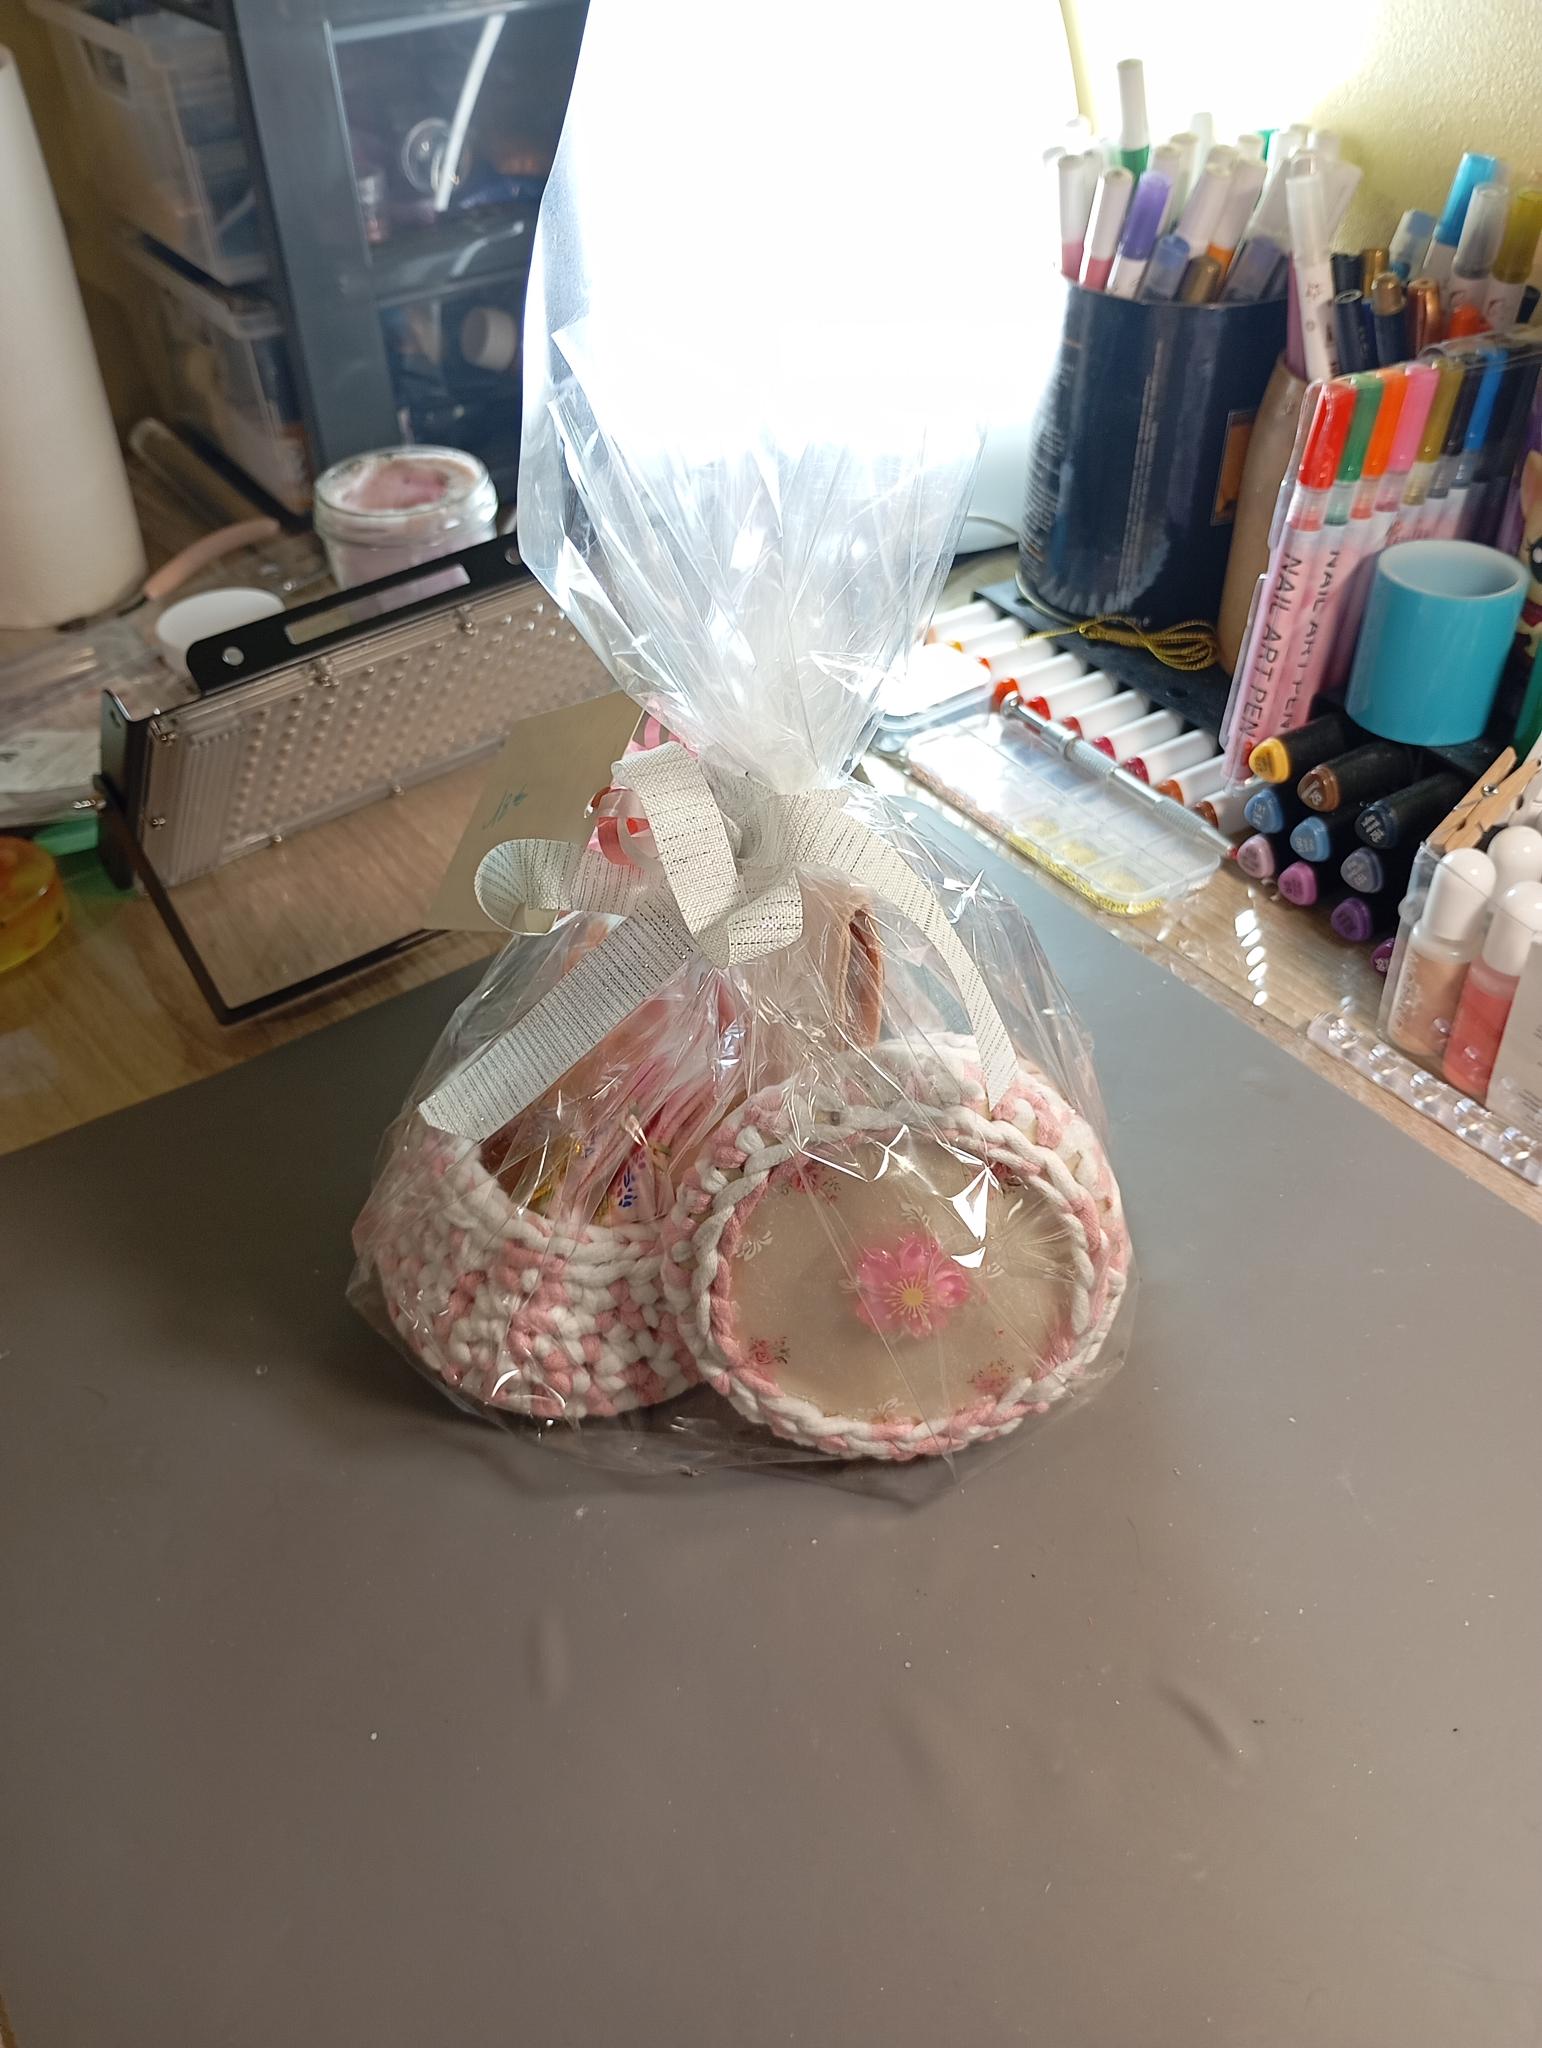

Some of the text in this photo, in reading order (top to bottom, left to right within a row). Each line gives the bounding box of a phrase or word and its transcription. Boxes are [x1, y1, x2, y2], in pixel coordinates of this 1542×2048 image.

[1268, 552, 1302, 614] NAIL
[1312, 550, 1340, 612] NAIL
[1254, 623, 1282, 682] ART
[1238, 684, 1268, 738] PEN
